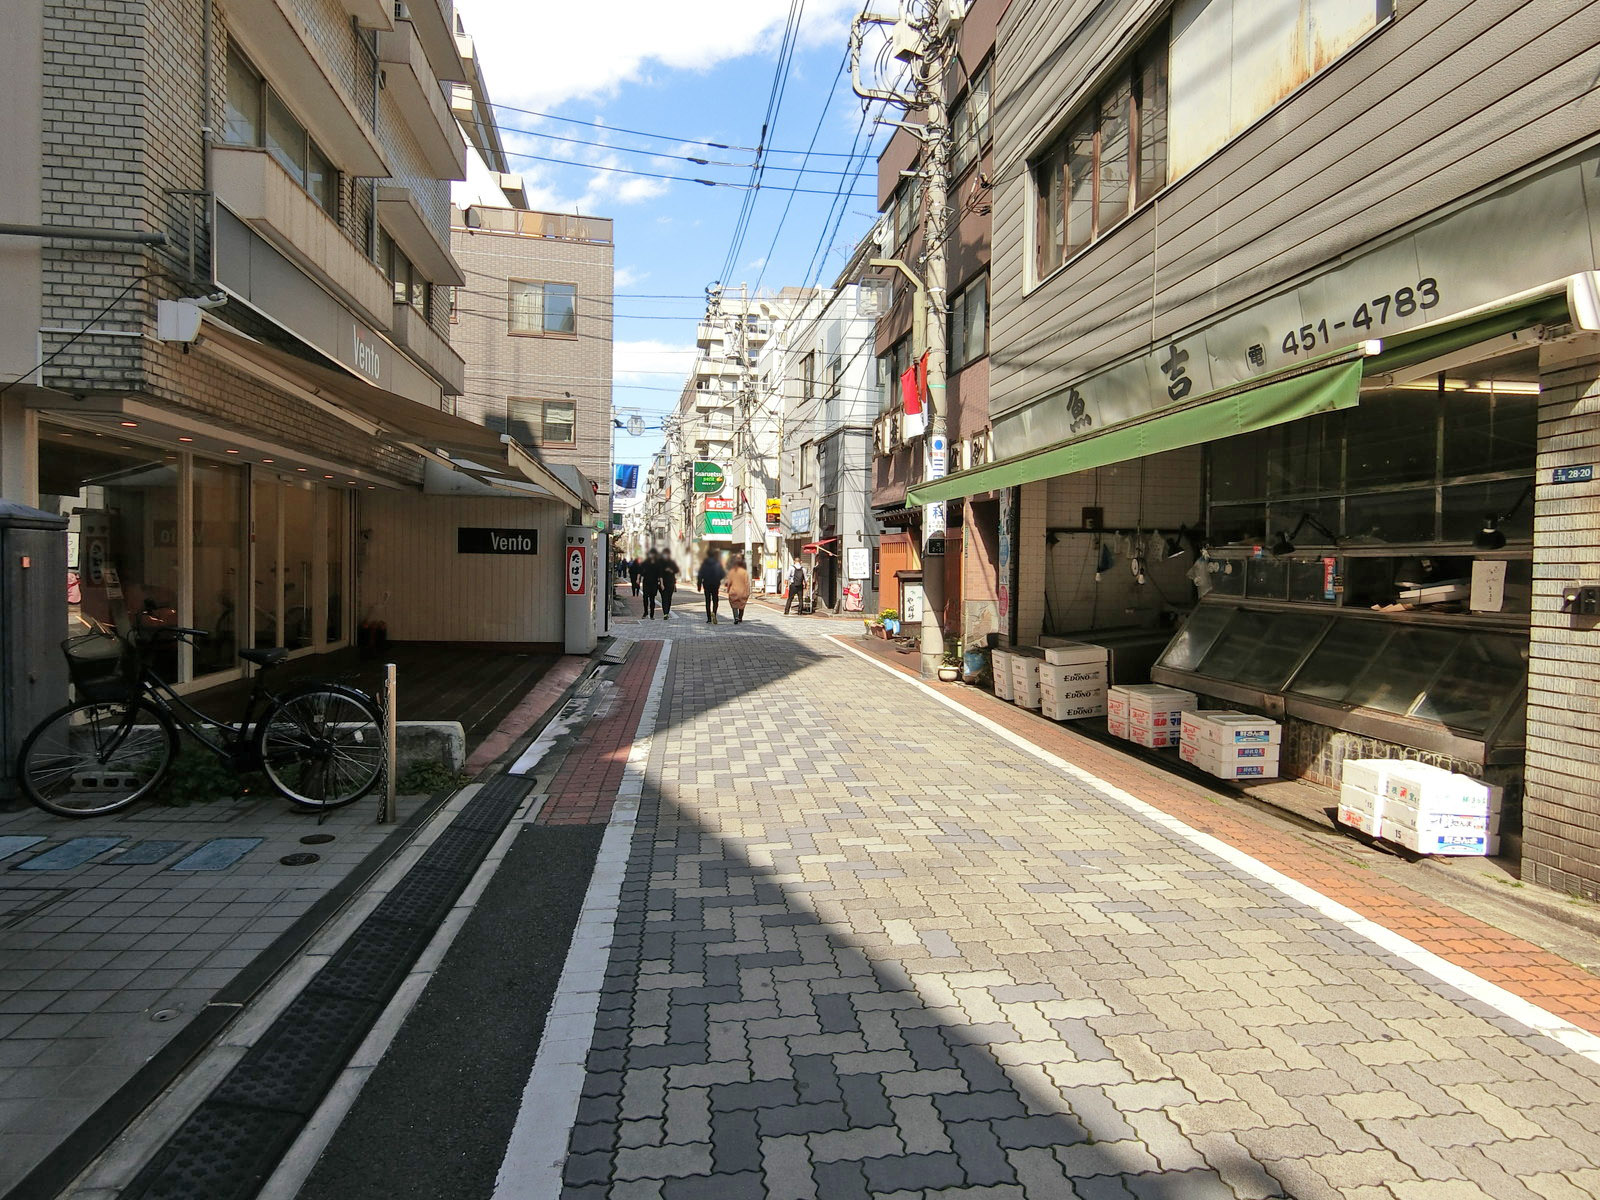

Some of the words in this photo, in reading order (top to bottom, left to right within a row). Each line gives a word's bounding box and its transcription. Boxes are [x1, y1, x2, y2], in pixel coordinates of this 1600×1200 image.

[1281, 277, 1441, 357] 451-4783
[353, 324, 380, 379] Vento
[490, 531, 532, 551] Vento
[572, 553, 582, 587] たばこ
[1063, 673, 1090, 682] EDONO
[1065, 690, 1091, 699] EDONO
[1067, 708, 1093, 716] EDONO
[1395, 829, 1402, 839] 15
